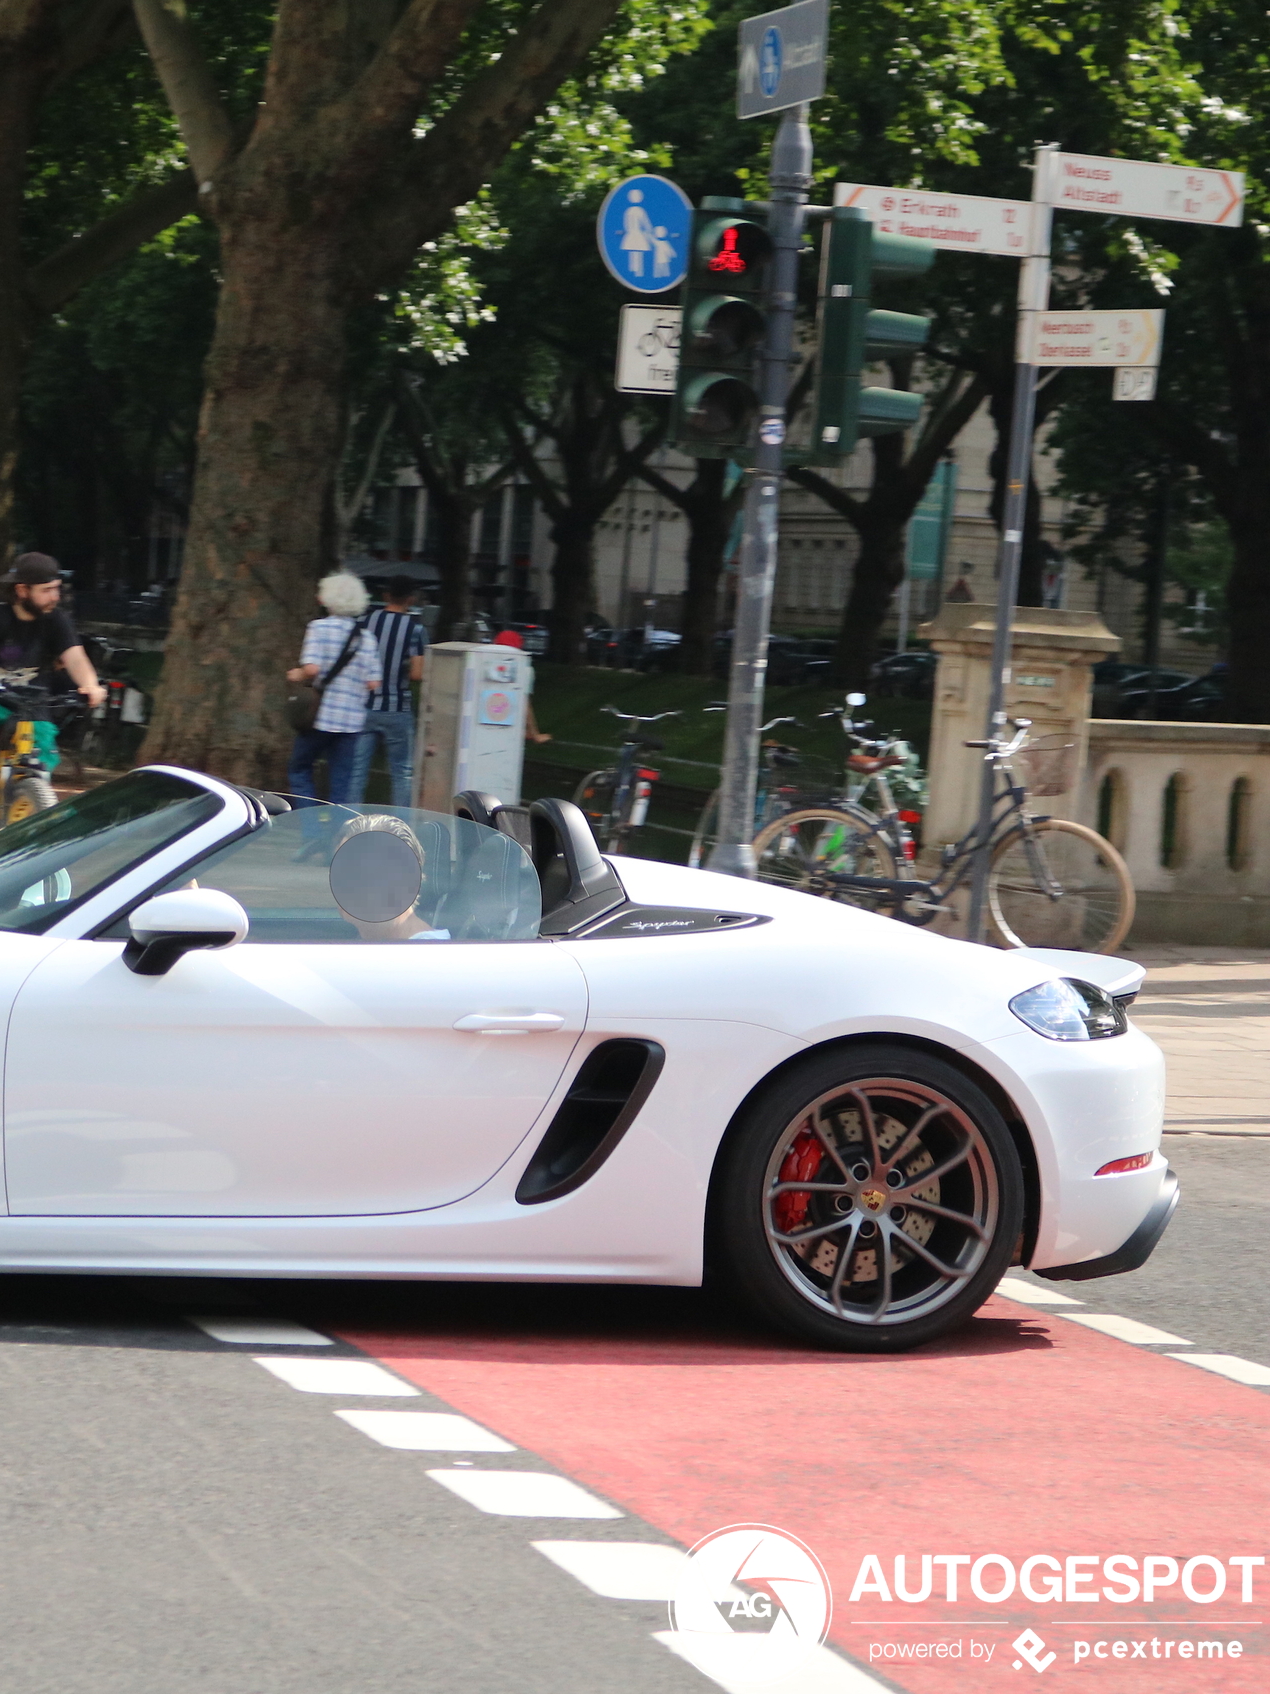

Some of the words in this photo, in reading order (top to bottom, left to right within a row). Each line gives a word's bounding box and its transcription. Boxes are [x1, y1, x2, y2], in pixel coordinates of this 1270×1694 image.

[1063, 162, 1113, 182] Neuss
[1062, 184, 1123, 206] Altstadt
[622, 919, 695, 930] Spyder
